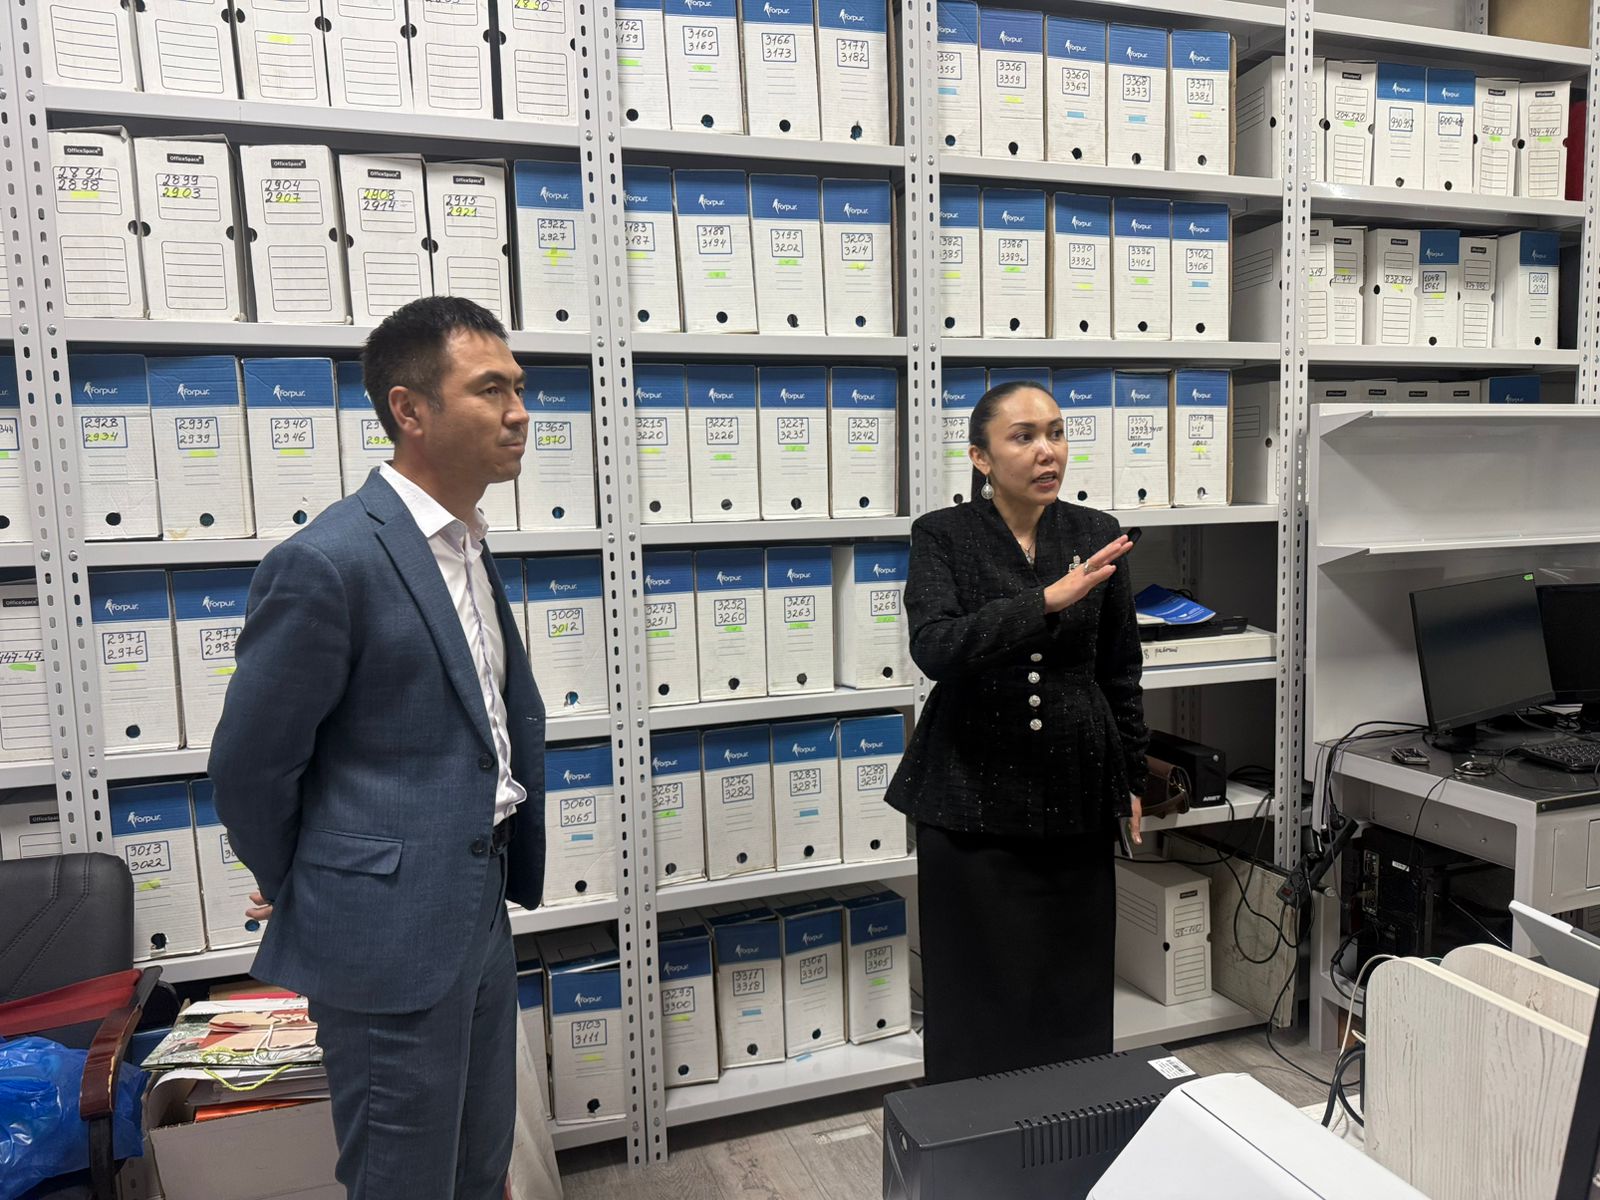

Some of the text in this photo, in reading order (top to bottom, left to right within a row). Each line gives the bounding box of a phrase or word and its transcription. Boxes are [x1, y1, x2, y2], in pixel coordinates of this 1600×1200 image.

[687, 28, 714, 39] 3160
[688, 40, 715, 51] 3165
[765, 35, 791, 45] 3166
[766, 48, 792, 59] 3173
[840, 52, 868, 63] 3182
[999, 61, 1022, 71] 3356
[1065, 69, 1089, 80] 3360
[1064, 80, 1088, 91] 3367
[57, 167, 103, 180] 2891
[58, 180, 100, 191] 2898
[164, 175, 199, 185] 2899
[265, 180, 301, 191] 2904
[162, 188, 201, 198] 2903
[265, 192, 301, 203] 2907
[363, 190, 395, 200] 2908
[362, 200, 396, 211] 2914
[446, 195, 477, 206] 2915
[447, 206, 478, 216] 2921
[540, 232, 567, 242] 2927
[774, 230, 799, 241] 3195
[702, 239, 726, 249] 3194
[940, 237, 961, 247] 382
[774, 243, 799, 253] 3202
[844, 245, 869, 256] 3214
[940, 249, 959, 259] 385
[84, 418, 118, 429] 2928
[178, 418, 213, 431] 2935
[274, 418, 308, 430] 2940
[537, 422, 568, 433] 2965
[708, 418, 734, 429] 3221
[779, 418, 805, 429] 3227
[851, 419, 877, 429] 3236
[709, 430, 734, 440] 3226
[780, 429, 805, 440] 3235
[851, 430, 876, 441] 3242
[944, 429, 965, 440] 3412
[1068, 427, 1092, 436] 3423
[85, 432, 118, 443] 2934
[179, 432, 210, 444] 2939
[274, 431, 306, 444] 2946
[537, 435, 567, 446] 2970
[873, 591, 898, 601] 3264
[550, 610, 581, 621] 3009
[718, 612, 745, 623] 3260
[787, 609, 811, 618] 3263
[551, 622, 579, 634] 3012
[107, 633, 144, 645] 2971
[205, 629, 238, 641] 2977
[108, 646, 144, 659] 2976
[792, 770, 817, 781] 3283
[793, 780, 818, 792] 3287
[724, 786, 751, 798] 3282
[563, 799, 593, 810] 3060
[32, 815, 59, 823] OfficeSpac
[563, 812, 590, 824] 3065
[129, 843, 161, 857] 3013
[131, 858, 165, 870] 3022
[663, 1001, 692, 1012] 3300
